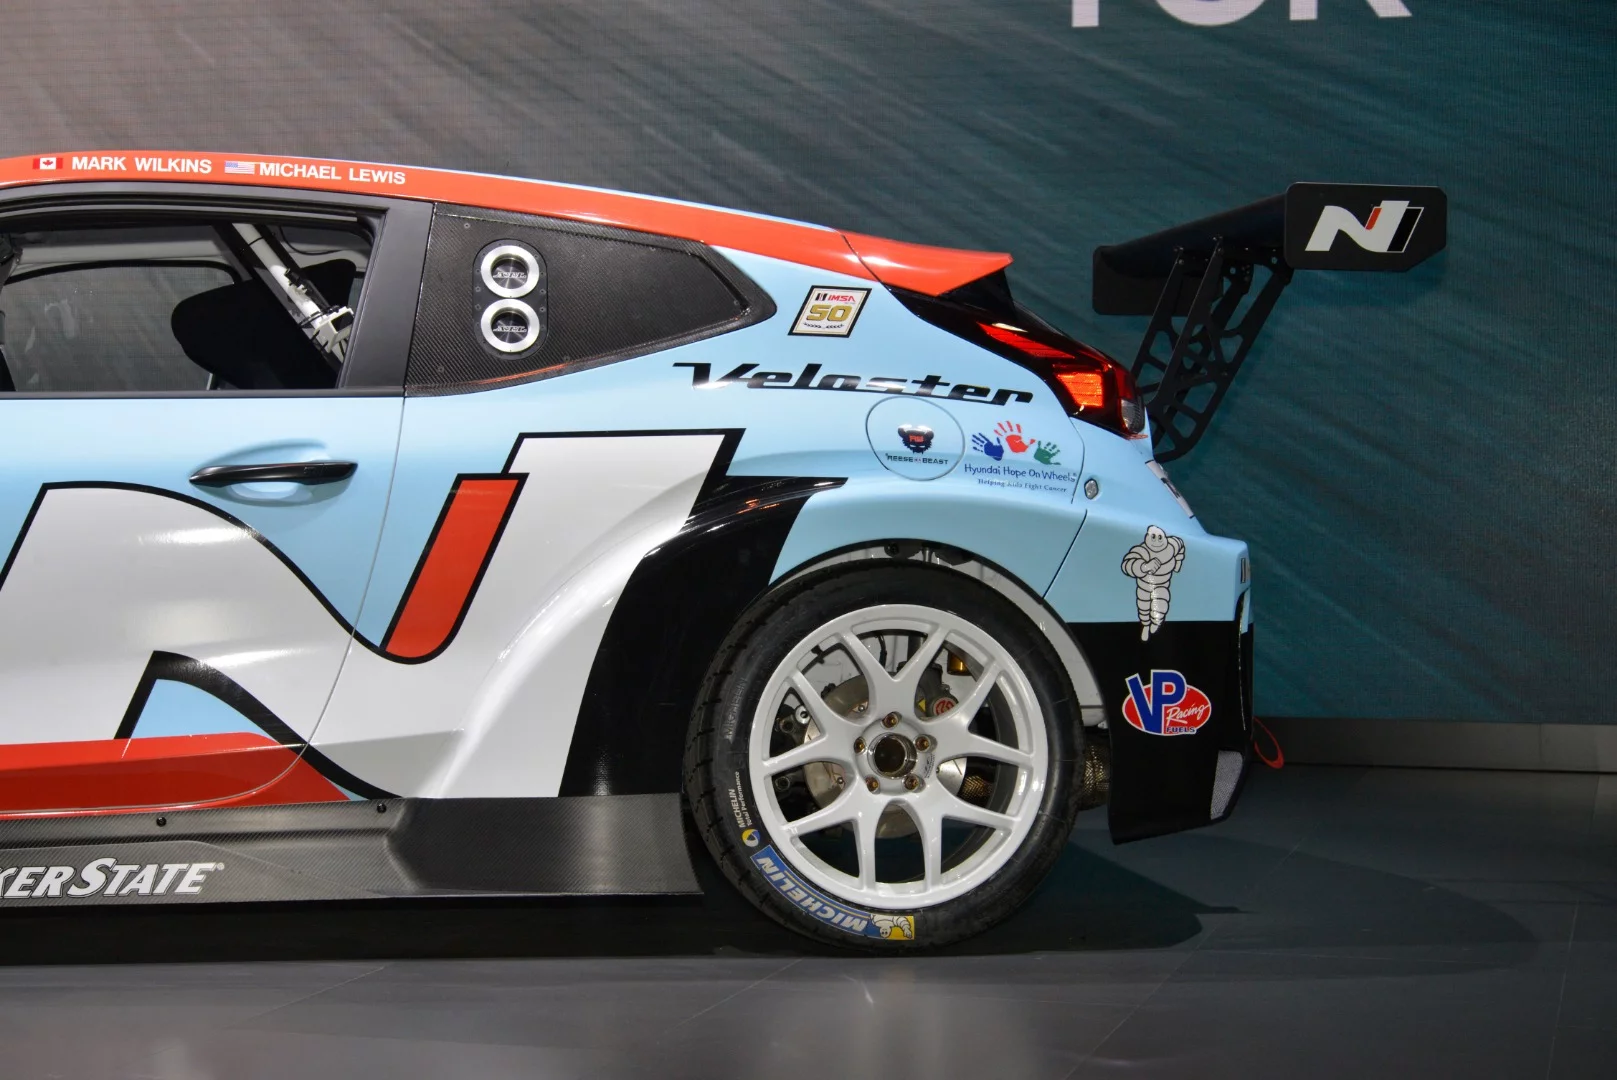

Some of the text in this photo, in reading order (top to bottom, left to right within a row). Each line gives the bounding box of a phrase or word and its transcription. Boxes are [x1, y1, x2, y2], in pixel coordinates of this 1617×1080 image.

[71, 156, 406, 185] MARK WILKINS MICHAEL LEWIS
[828, 294, 856, 302] IMSA
[806, 304, 853, 322] 50
[672, 362, 1034, 406] Veloster
[922, 457, 949, 465] BEAST
[964, 463, 1077, 483] Hyundai Hope On Wheels
[978, 478, 1005, 488] Helping
[1024, 483, 1042, 491] Fight
[1044, 485, 1068, 493] Cancer
[1125, 669, 1187, 735] VP
[1165, 702, 1210, 727] Racing
[1166, 726, 1196, 734] FUELS
[734, 771, 748, 811] Performance
[728, 788, 747, 828] MICHELIN
[757, 855, 869, 932] MICHELIN
